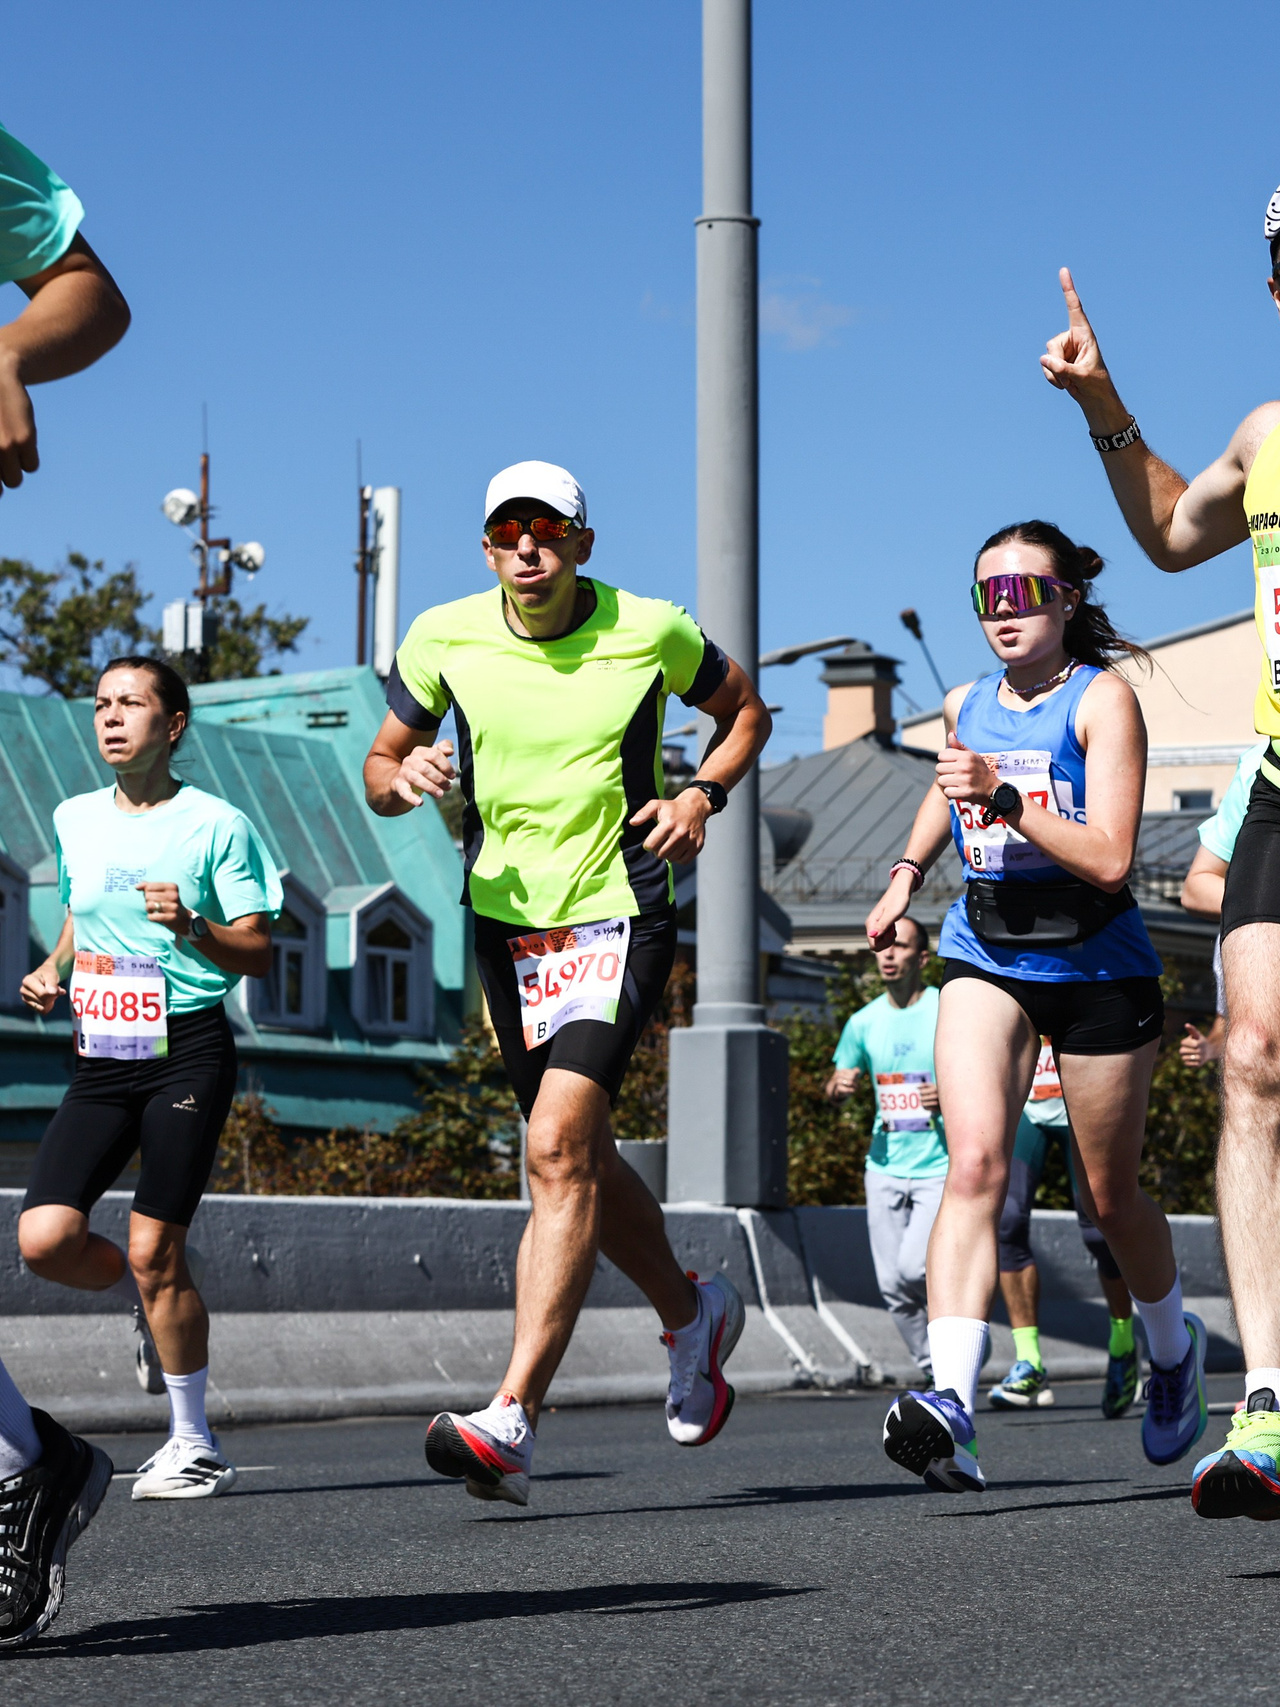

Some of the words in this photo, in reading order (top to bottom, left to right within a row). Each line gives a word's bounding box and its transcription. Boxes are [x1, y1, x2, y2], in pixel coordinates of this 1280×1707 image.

[973, 847, 982, 866] B
[523, 952, 619, 1007] 54970
[73, 987, 161, 1022] 54085
[537, 1021, 547, 1039] B
[881, 1092, 920, 1111] 5330
